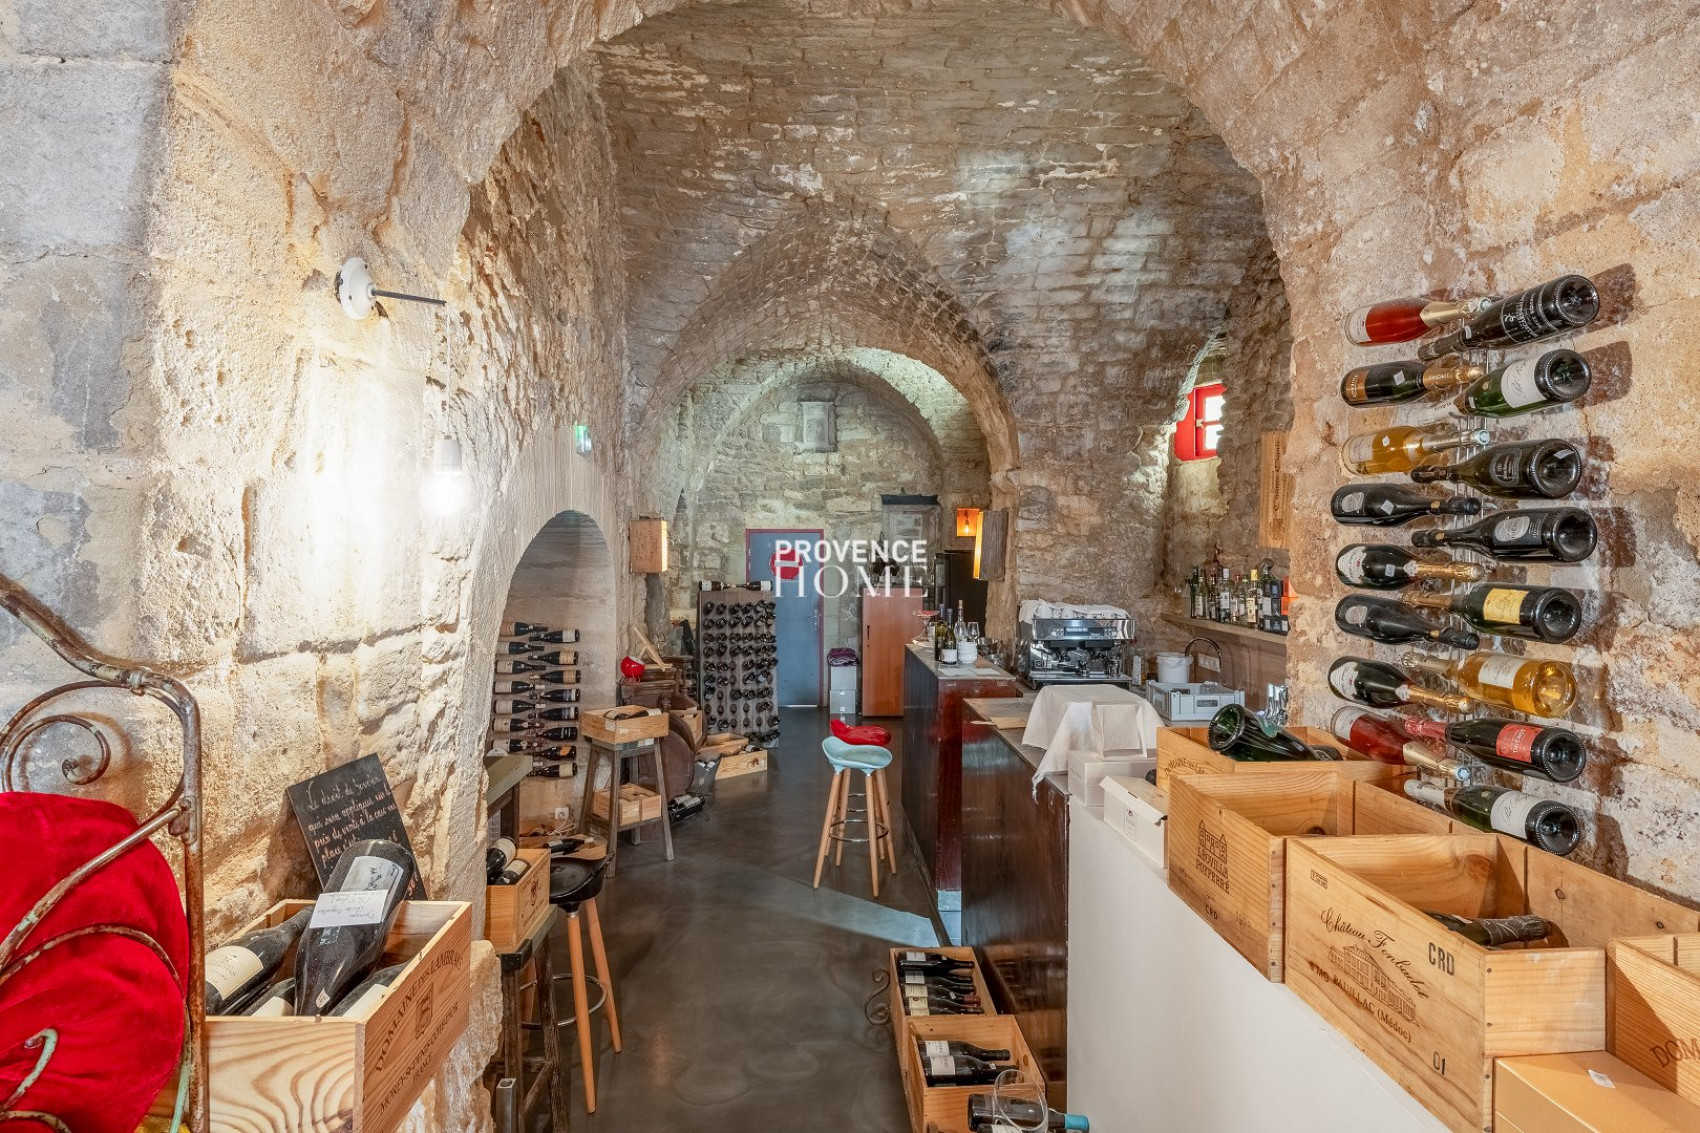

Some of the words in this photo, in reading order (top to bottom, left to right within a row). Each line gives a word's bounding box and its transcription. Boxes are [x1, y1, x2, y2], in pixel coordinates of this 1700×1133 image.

[1205, 904, 1218, 920] CRD
[1320, 906, 1367, 942] Château
[1368, 929, 1430, 1000] Fonbadet
[1428, 941, 1456, 977] CRD
[375, 981, 419, 1072] DOMAINE
[1432, 1051, 1446, 1076] 01
